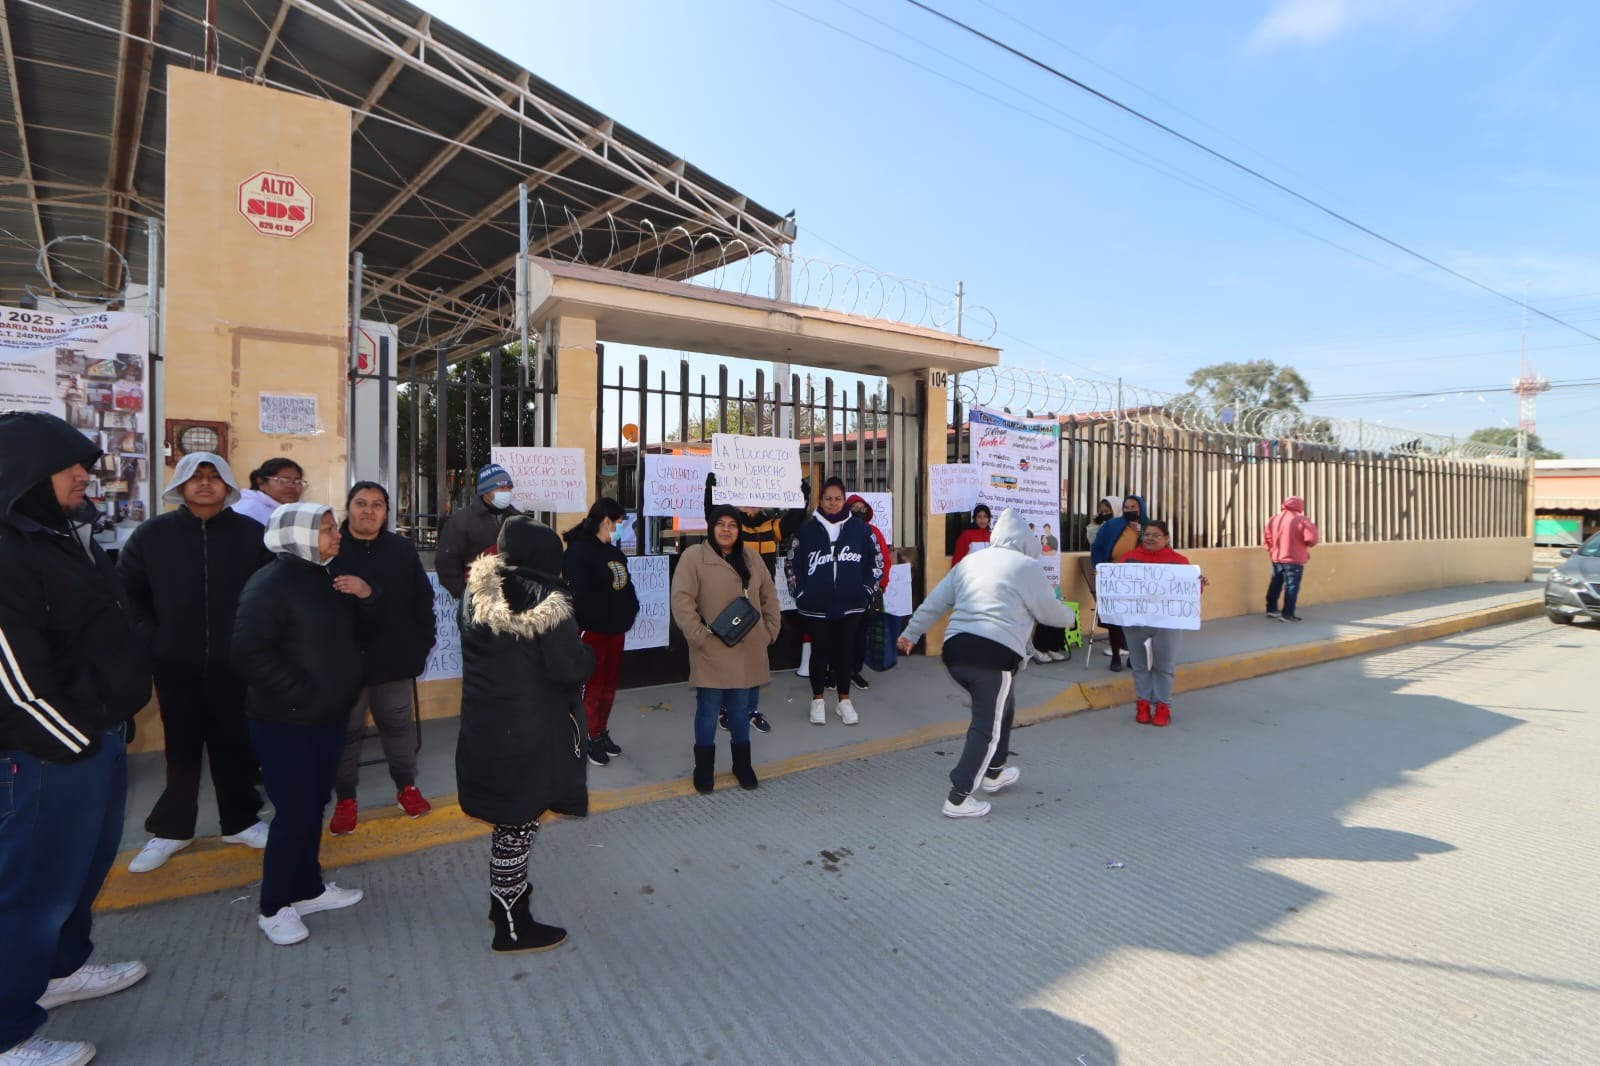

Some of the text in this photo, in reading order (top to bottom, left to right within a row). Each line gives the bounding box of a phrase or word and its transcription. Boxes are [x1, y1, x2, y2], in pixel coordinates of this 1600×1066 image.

[261, 177, 294, 197] ALTO
[248, 199, 305, 221] SDS
[9, 311, 54, 326] 2025
[71, 314, 108, 327] 2026
[31, 325, 66, 334] DAMIAN
[931, 372, 947, 388] 104
[716, 436, 729, 457] LA
[494, 450, 506, 464] LA
[563, 455, 577, 465] ES
[560, 467, 577, 476] QUE
[656, 456, 699, 480] GALLARDO
[714, 461, 787, 478] ES UN DERECHO
[651, 480, 704, 495] DANOS UNA
[735, 478, 749, 490] NO
[752, 478, 763, 490] SE
[766, 478, 782, 490] LES
[1170, 580, 1199, 596] PARA
[1162, 600, 1200, 618] HIJOS
